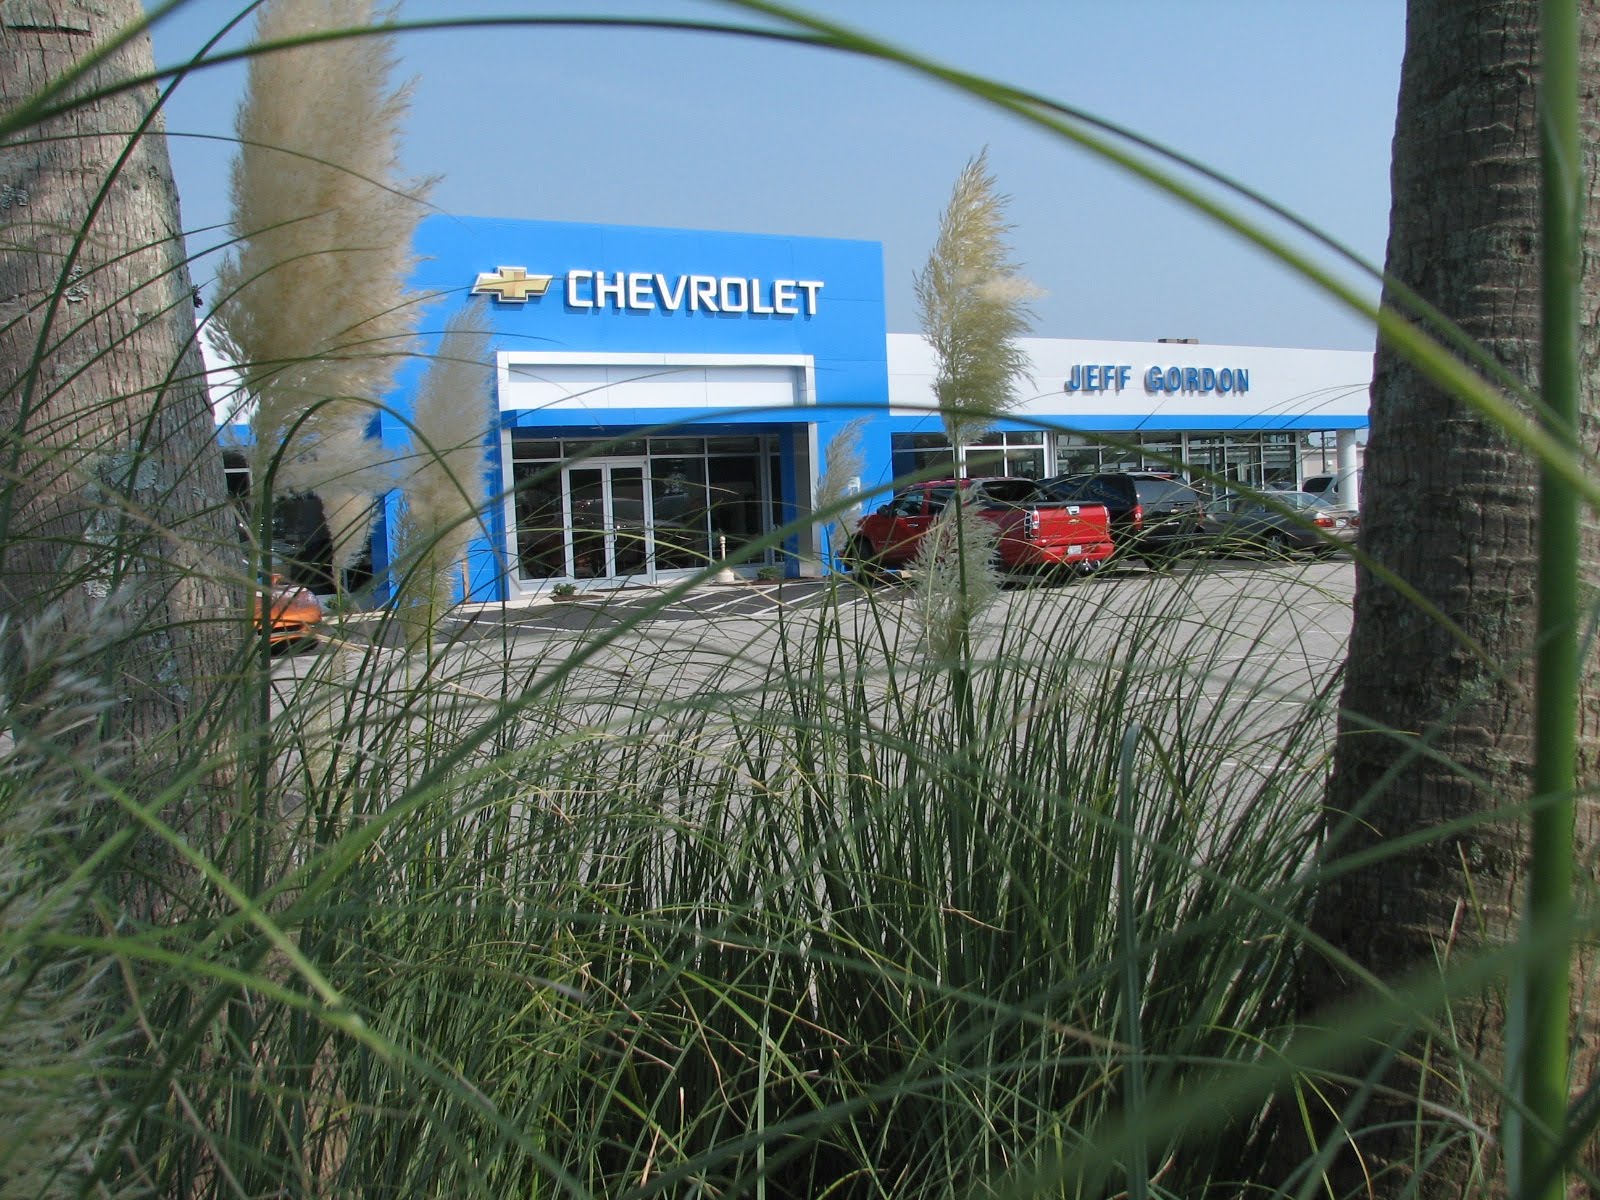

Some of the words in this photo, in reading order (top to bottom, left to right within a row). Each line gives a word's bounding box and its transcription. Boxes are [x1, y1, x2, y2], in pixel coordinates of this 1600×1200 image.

[566, 270, 824, 315] CHEVROLET
[1066, 364, 1131, 392] JEFF
[1145, 365, 1249, 393] GORDON
